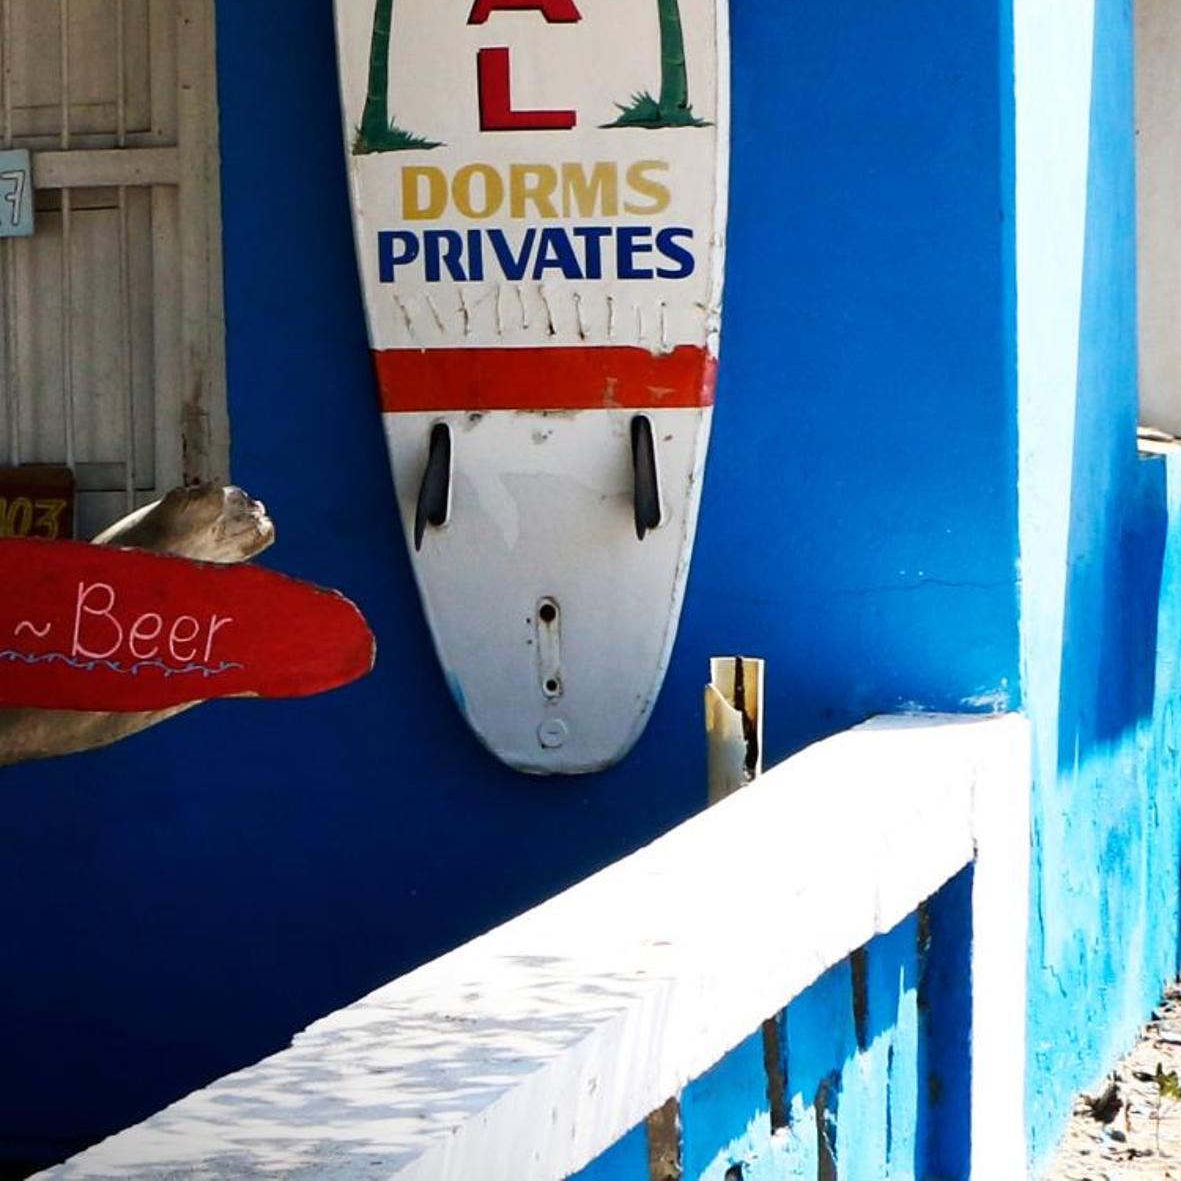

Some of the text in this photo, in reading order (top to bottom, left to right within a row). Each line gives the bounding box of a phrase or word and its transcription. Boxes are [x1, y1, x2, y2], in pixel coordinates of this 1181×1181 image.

[401, 160, 671, 219] DORMS
[376, 226, 696, 282] PRIVATES
[71, 581, 233, 662] Beer
